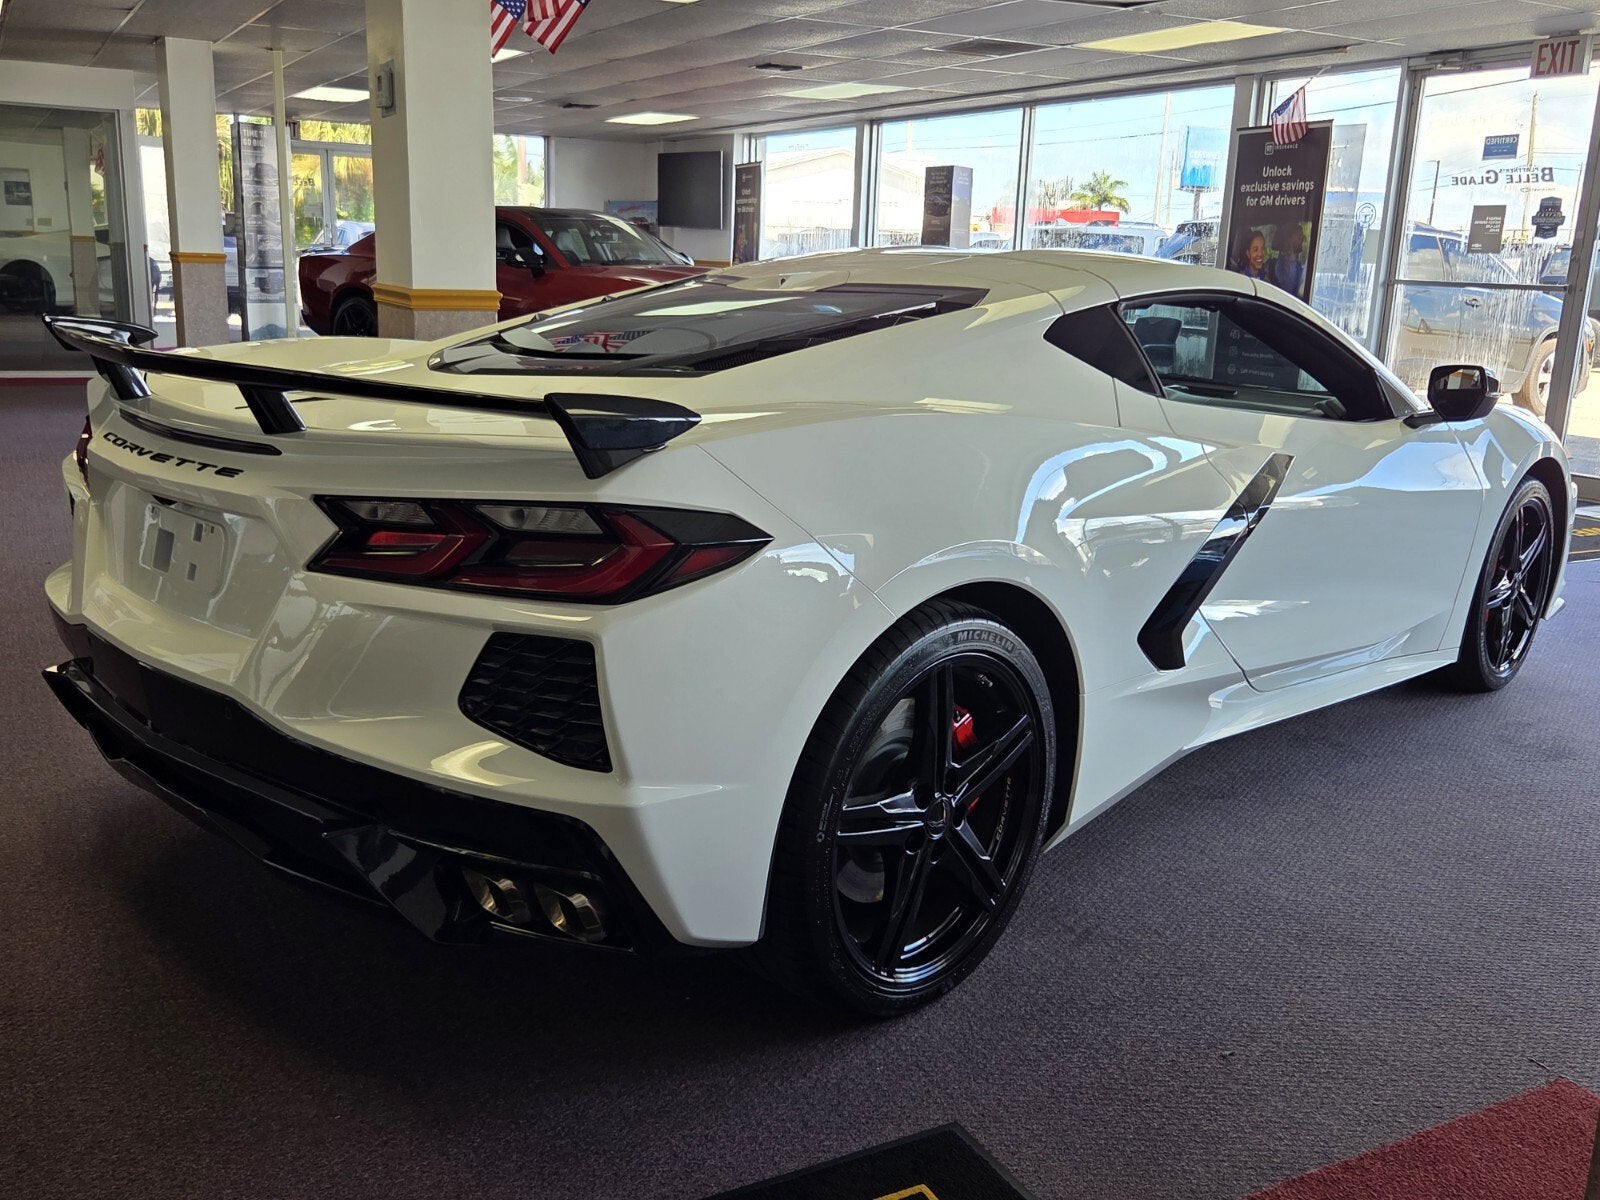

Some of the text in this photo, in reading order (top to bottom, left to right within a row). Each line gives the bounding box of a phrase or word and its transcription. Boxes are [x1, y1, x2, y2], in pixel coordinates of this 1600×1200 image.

[1535, 40, 1580, 75] EXIT
[1262, 165, 1292, 178] Unlock
[1240, 179, 1314, 193] exclusive savings
[1246, 194, 1306, 207] for GM drivers
[103, 431, 245, 478] CORVETTE
[957, 630, 1015, 652] MICHELIN
